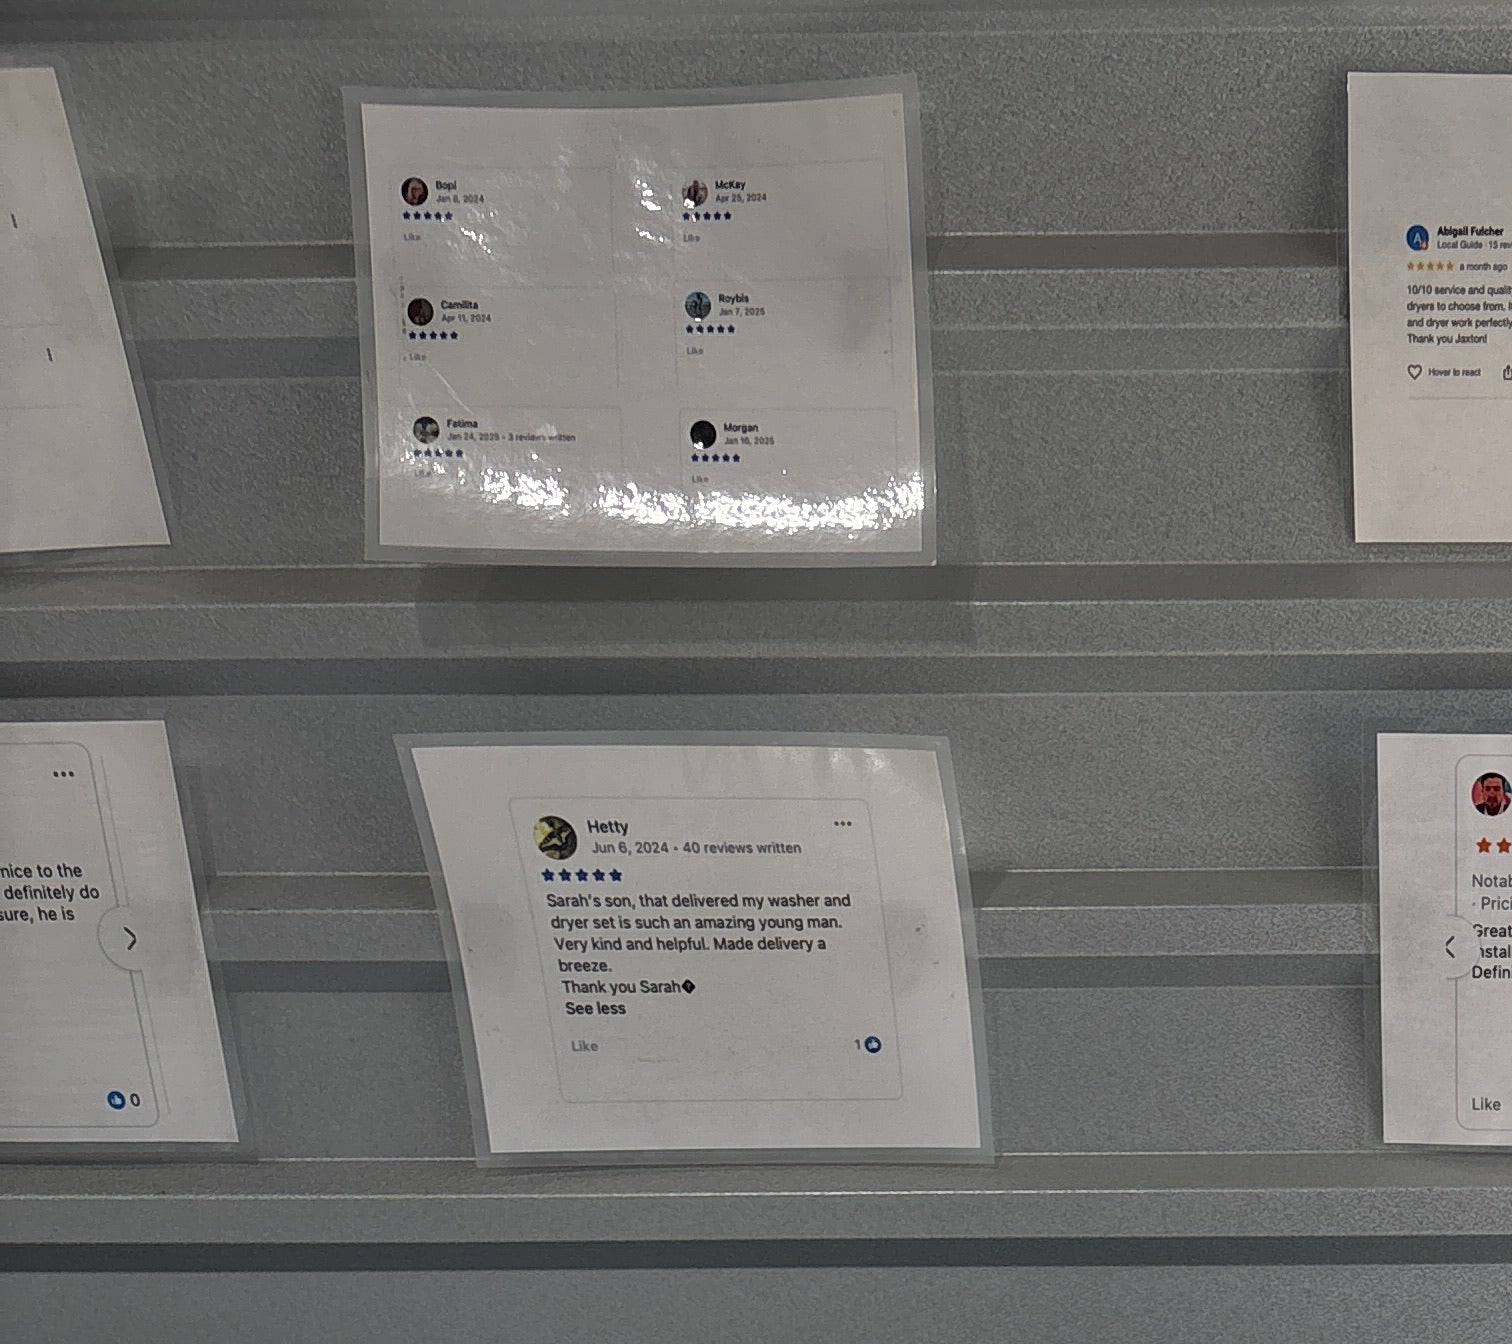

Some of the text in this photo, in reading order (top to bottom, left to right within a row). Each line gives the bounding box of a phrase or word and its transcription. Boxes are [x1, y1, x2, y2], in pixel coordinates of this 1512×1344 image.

[1436, 225, 1505, 239] Abigail Fulcher
[1407, 284, 1433, 295] 10/10
[1434, 284, 1467, 296] service
[1467, 284, 1486, 295] and
[1407, 332, 1488, 346] Thank you Jaxton!
[446, 418, 479, 429] Fatima
[723, 422, 759, 435] Morgan
[586, 819, 629, 837] Hetty
[36, 864, 53, 879] to
[56, 862, 83, 878] the
[3, 884, 100, 903] definitely do
[546, 893, 852, 910] Sarah's son, that delivered my washer and
[36, 906, 58, 922] he
[60, 905, 75, 921] is
[557, 958, 613, 973] breeze.
[560, 979, 607, 994] Thank
[609, 982, 637, 997] you
[565, 1001, 627, 1016] See less
[1471, 1096, 1502, 1112] Like
